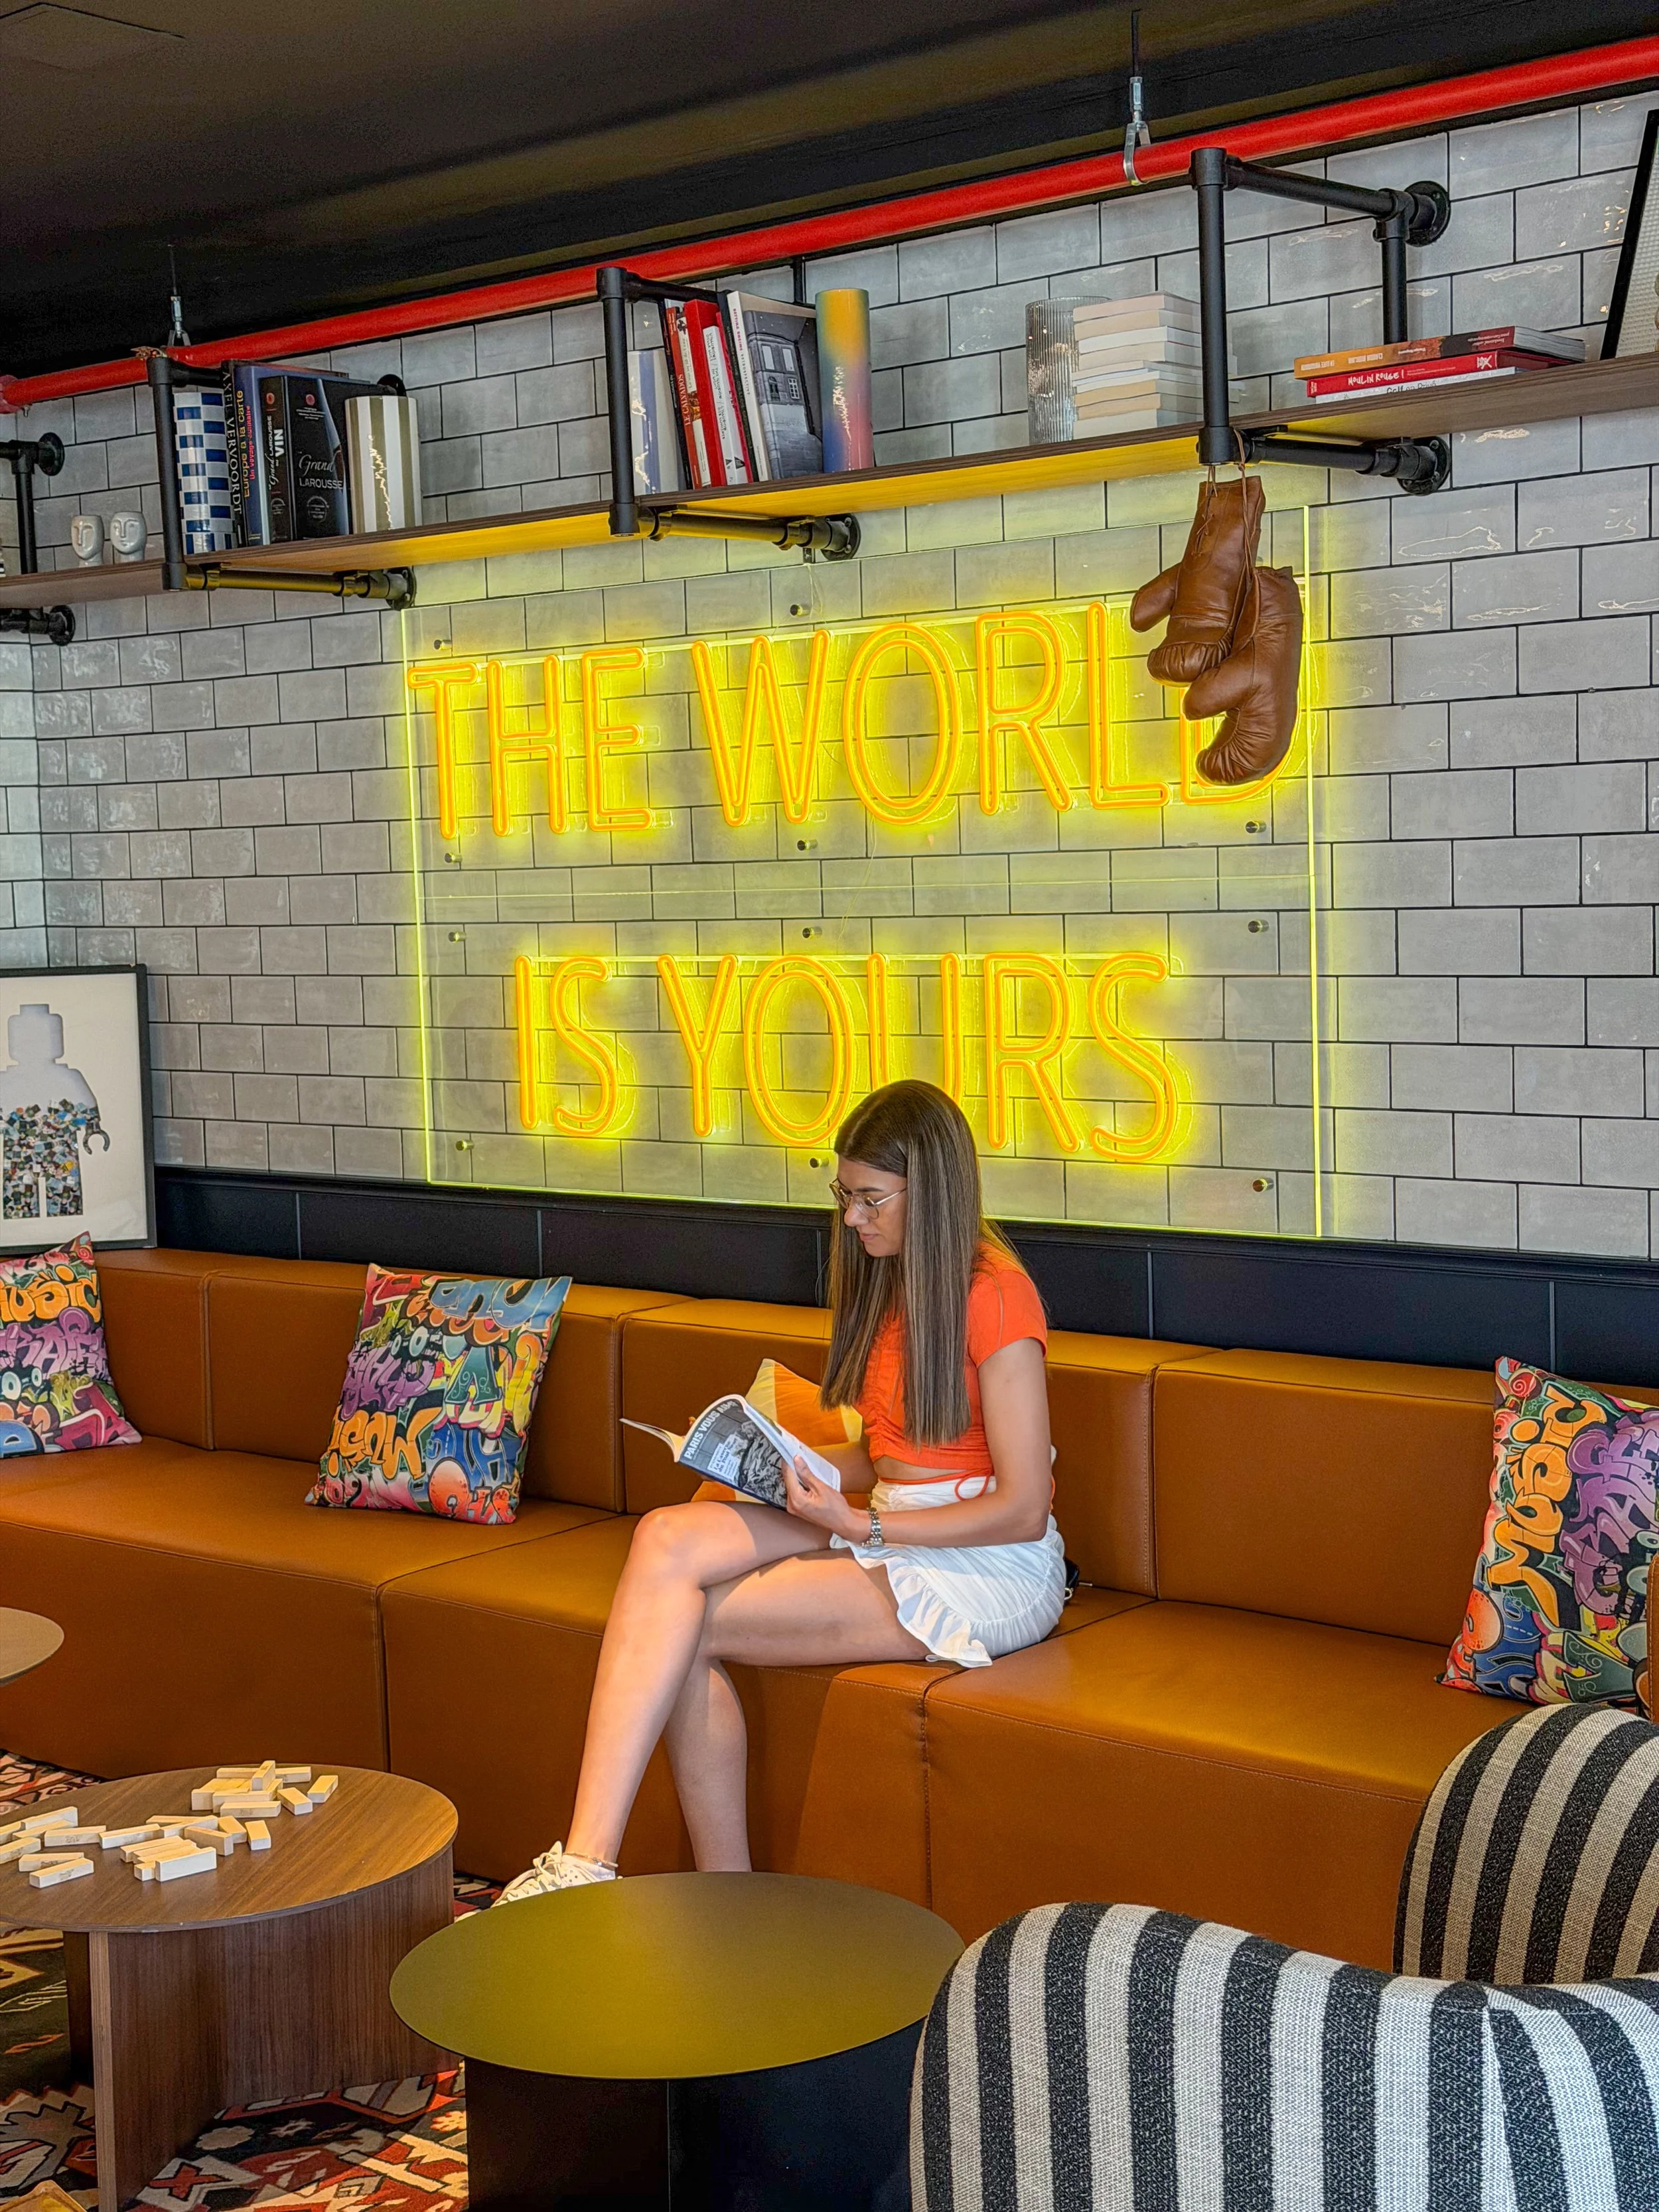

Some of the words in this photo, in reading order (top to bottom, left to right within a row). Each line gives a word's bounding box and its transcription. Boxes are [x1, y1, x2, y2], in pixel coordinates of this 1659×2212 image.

[678, 374, 689, 414] CALVADOS
[1348, 374, 1374, 386] MOULIN
[1376, 372, 1400, 382] ROUGE
[236, 390, 245, 423] carte
[240, 426, 246, 438] la
[274, 429, 285, 457] VIN
[226, 417, 242, 514] VERVOORDT
[241, 455, 250, 498] Europe
[299, 451, 340, 476] Grand
[299, 478, 344, 490] LAROUSSE
[405, 646, 654, 840] THE
[515, 956, 620, 1137] IS
[658, 952, 1179, 1164] YOURS
[0, 1264, 102, 1323] USIC
[325, 1404, 443, 1481] MUSI
[684, 1432, 703, 1459] PARIS
[698, 1410, 720, 1432] VOUS
[1486, 1383, 1607, 1629] MUSIC
